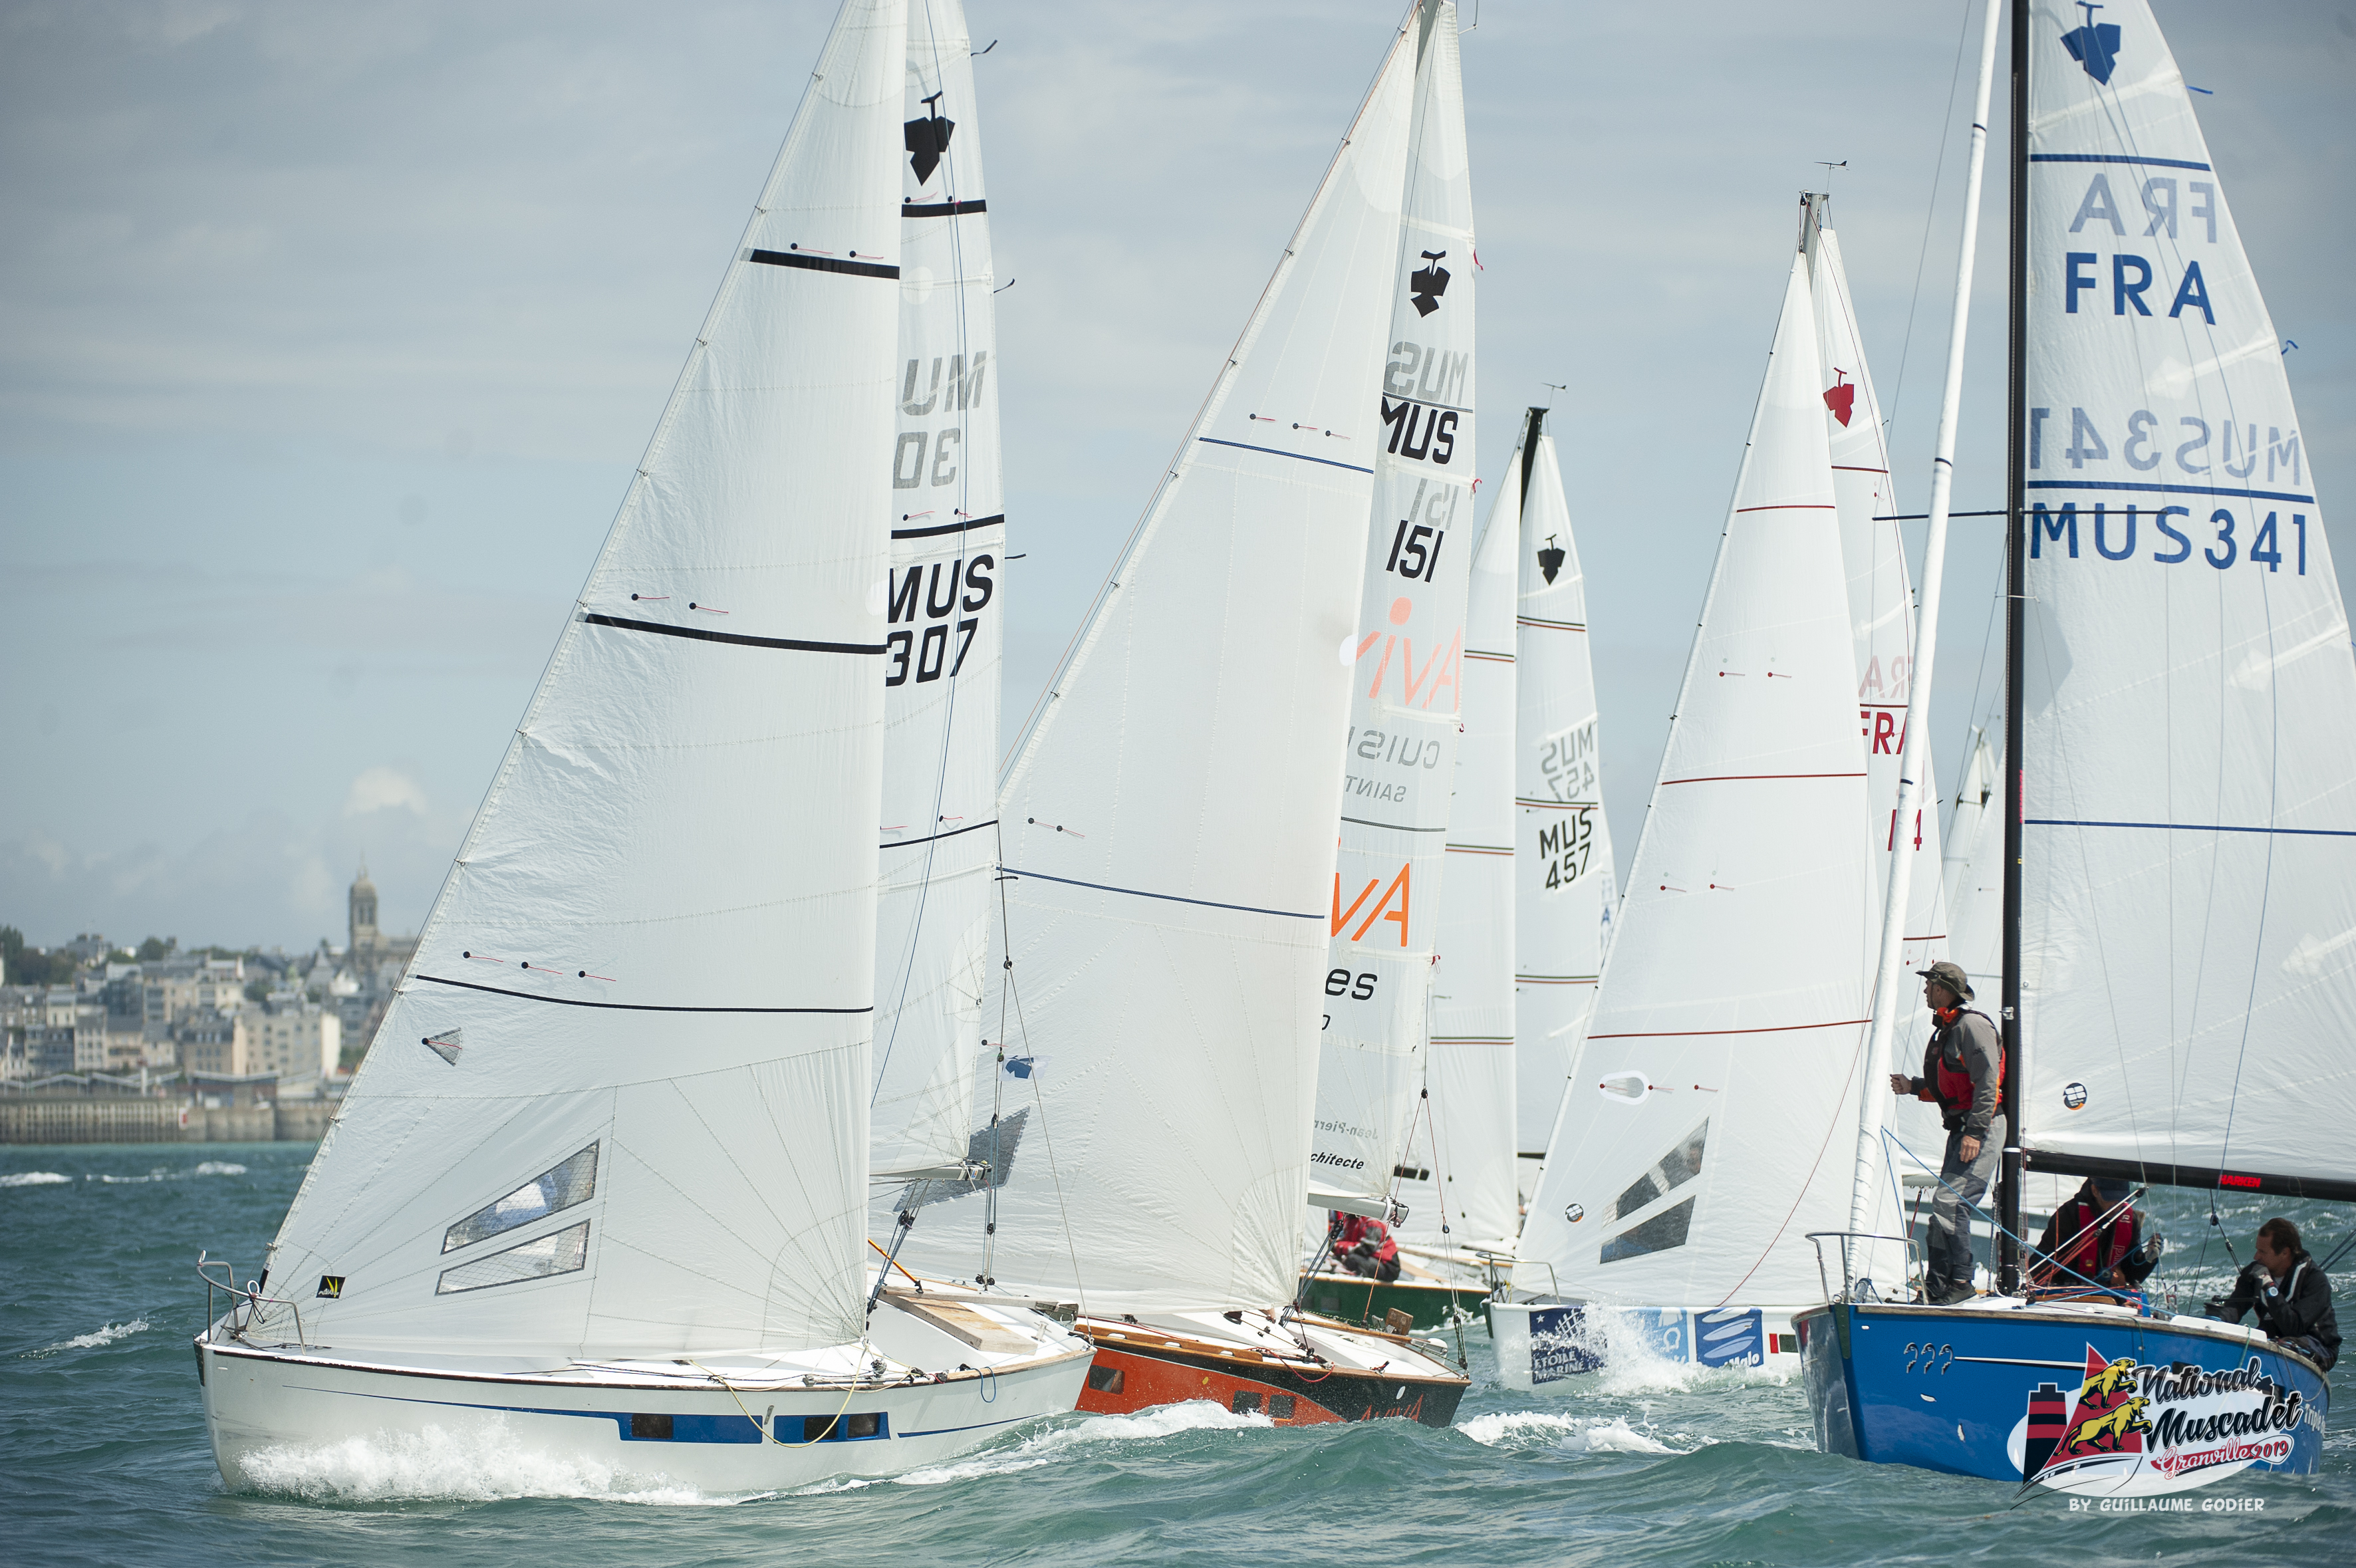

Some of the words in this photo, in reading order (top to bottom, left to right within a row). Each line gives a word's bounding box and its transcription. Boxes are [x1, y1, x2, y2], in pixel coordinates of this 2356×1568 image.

[2065, 252, 2216, 325] FRA
[1380, 396, 1459, 464] MUS
[1386, 519, 1444, 583] 151
[888, 554, 994, 624] MUS
[886, 617, 979, 687] 307
[1539, 804, 1593, 860] MUS
[1545, 841, 1591, 890] 457
[1325, 968, 1378, 1001] es
[1311, 1152, 1364, 1170] chitecte
